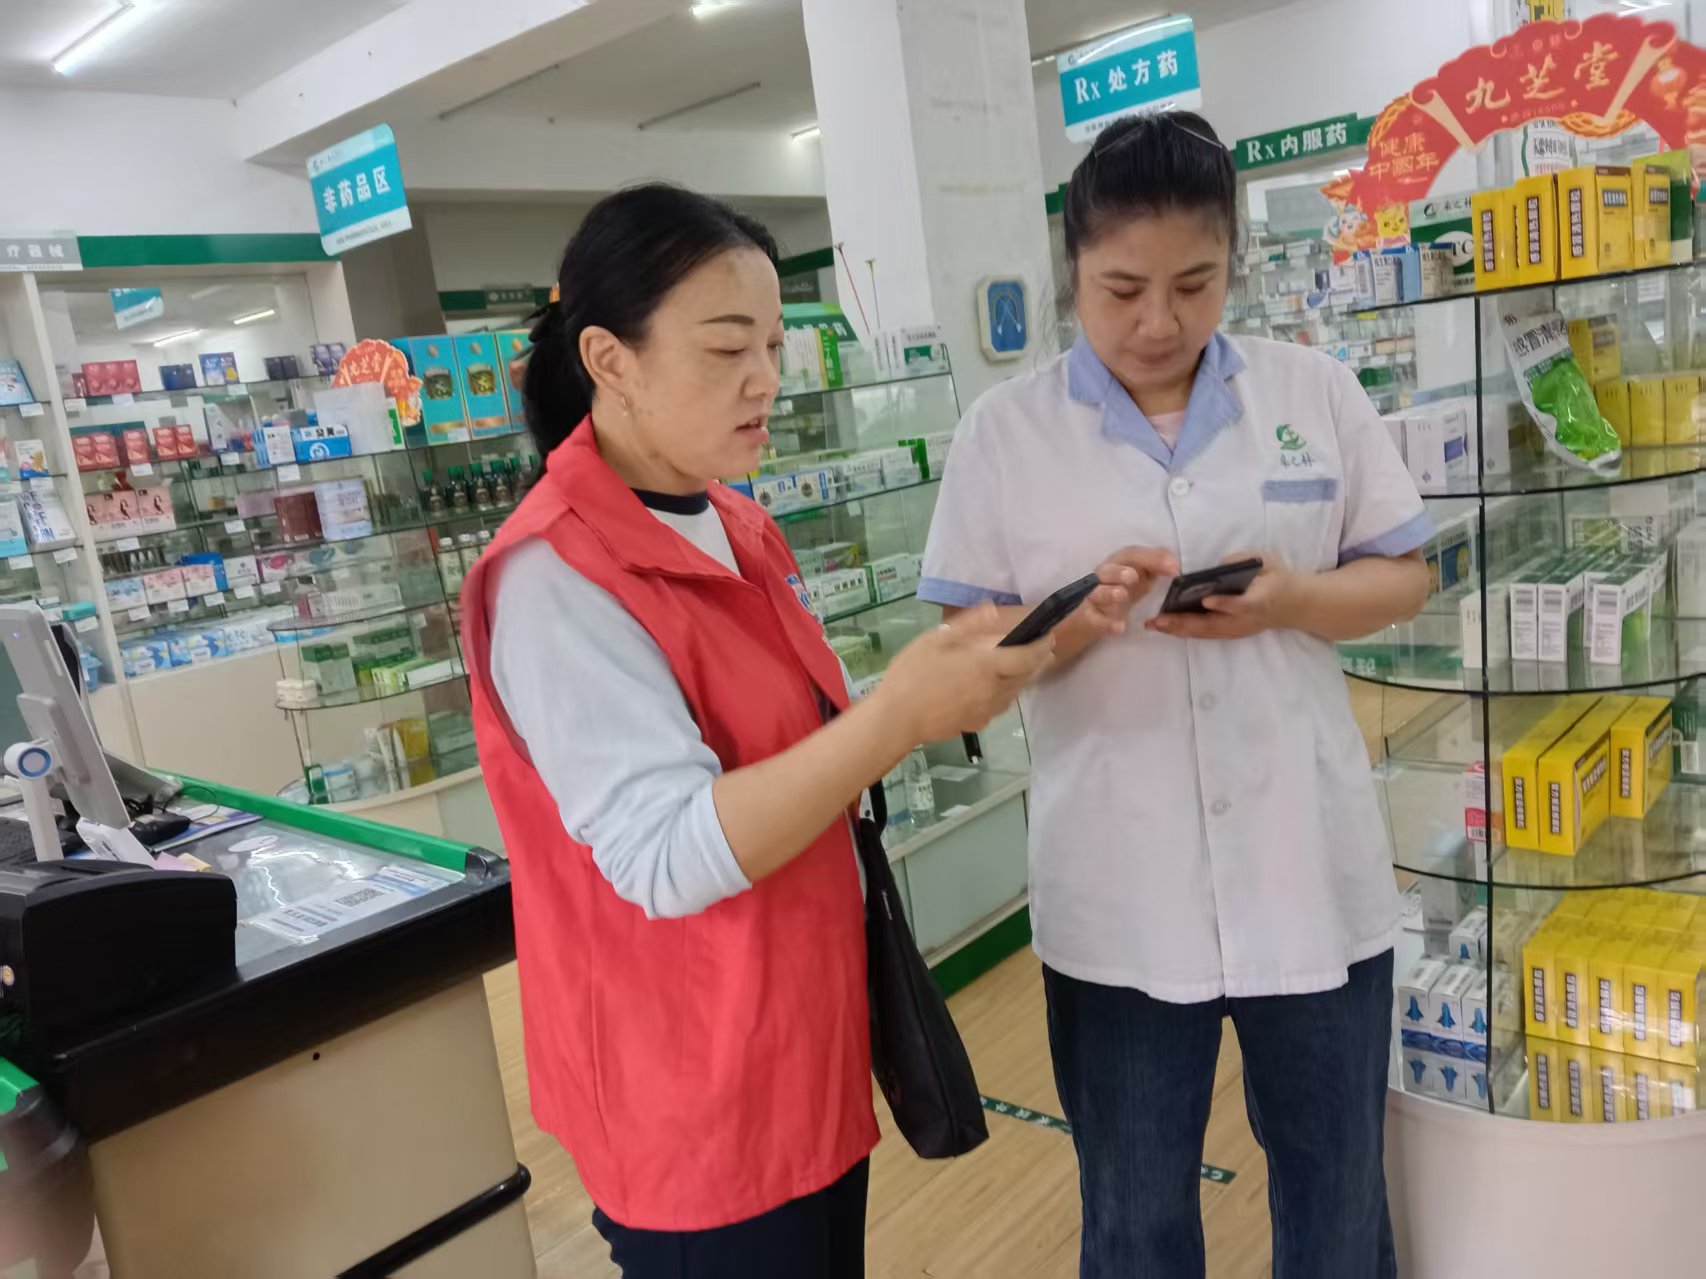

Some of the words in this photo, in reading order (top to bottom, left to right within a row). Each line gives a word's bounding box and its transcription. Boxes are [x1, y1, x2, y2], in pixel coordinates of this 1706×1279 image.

[1074, 77, 1101, 104] Rx
[1108, 49, 1178, 94] 处方药
[1466, 41, 1618, 114] 九芝堂
[1246, 140, 1276, 163] Rx
[1280, 122, 1348, 158] 内服药
[322, 165, 391, 214] 非药品区
[1452, 239, 1474, 257] TC
